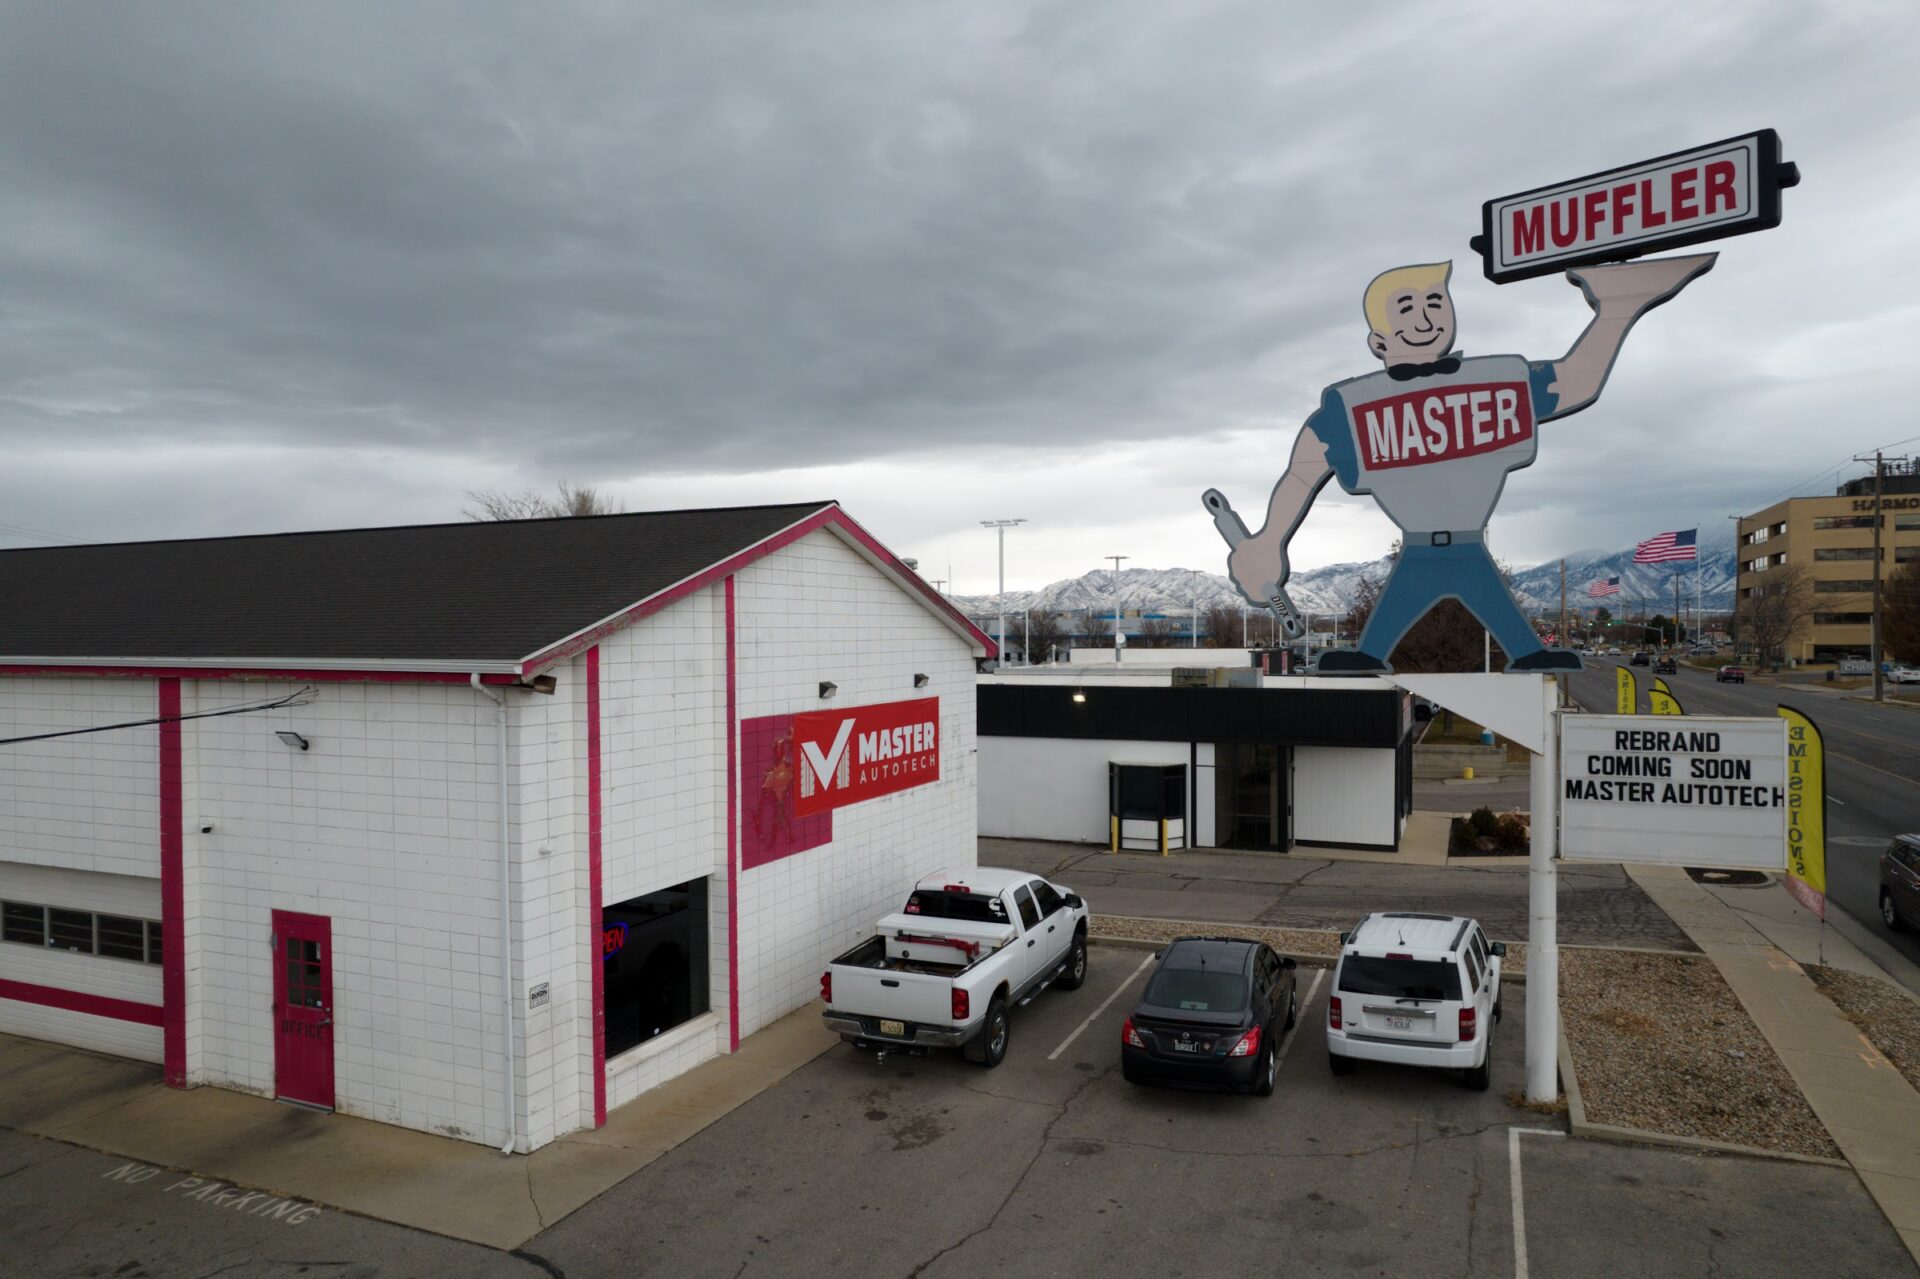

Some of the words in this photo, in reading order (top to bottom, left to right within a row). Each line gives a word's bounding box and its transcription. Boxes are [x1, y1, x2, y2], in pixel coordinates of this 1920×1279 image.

[1512, 160, 1737, 256] MUFFLER
[1365, 388, 1521, 464] MASTER
[859, 721, 935, 765] MASTER
[1615, 730, 1721, 753] REBRAND
[860, 753, 936, 785] AUTOTECH
[1587, 755, 1672, 778] COMING
[1690, 758, 1752, 780] SOON
[1565, 780, 1655, 803] MASTER
[1662, 783, 1785, 808] AUTOTECH
[603, 927, 625, 952] PEN
[281, 1019, 323, 1040] OFFICE
[102, 1162, 161, 1184] NO
[163, 1177, 321, 1224] PARKING
